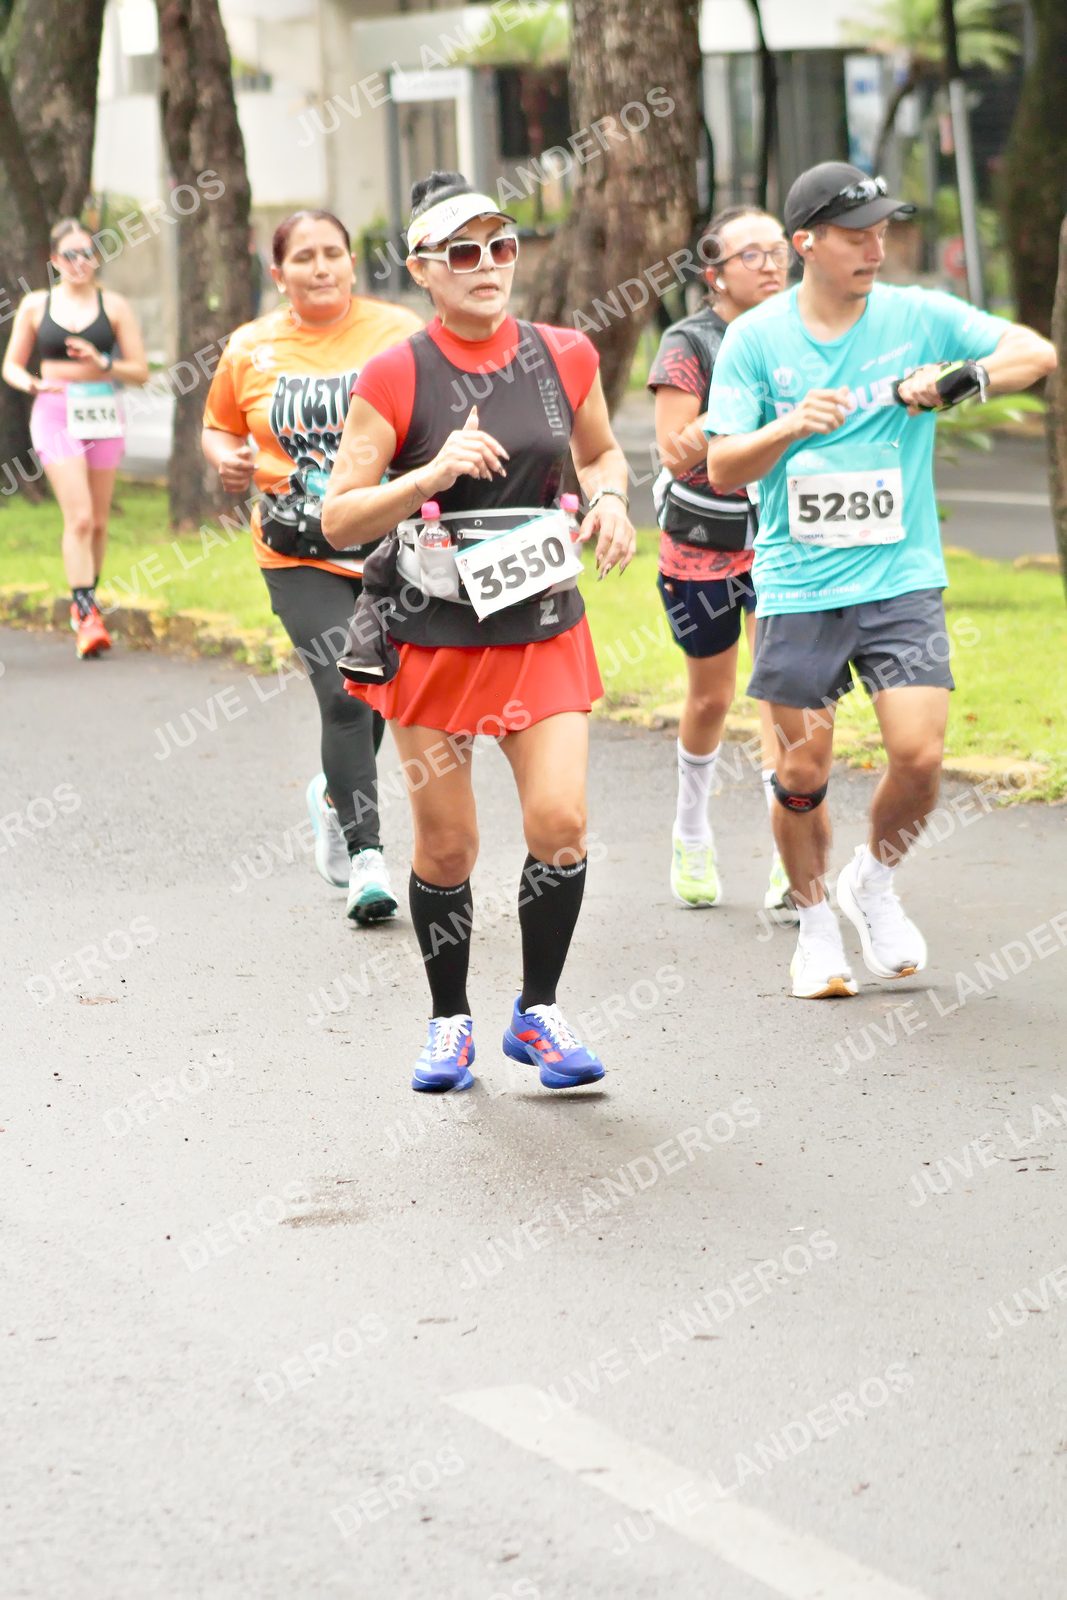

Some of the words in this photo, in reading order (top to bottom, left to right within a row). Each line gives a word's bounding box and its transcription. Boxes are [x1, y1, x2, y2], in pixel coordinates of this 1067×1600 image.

[278, 431, 343, 460] BARR
[798, 489, 894, 524] 5280
[472, 537, 565, 601] 3550
